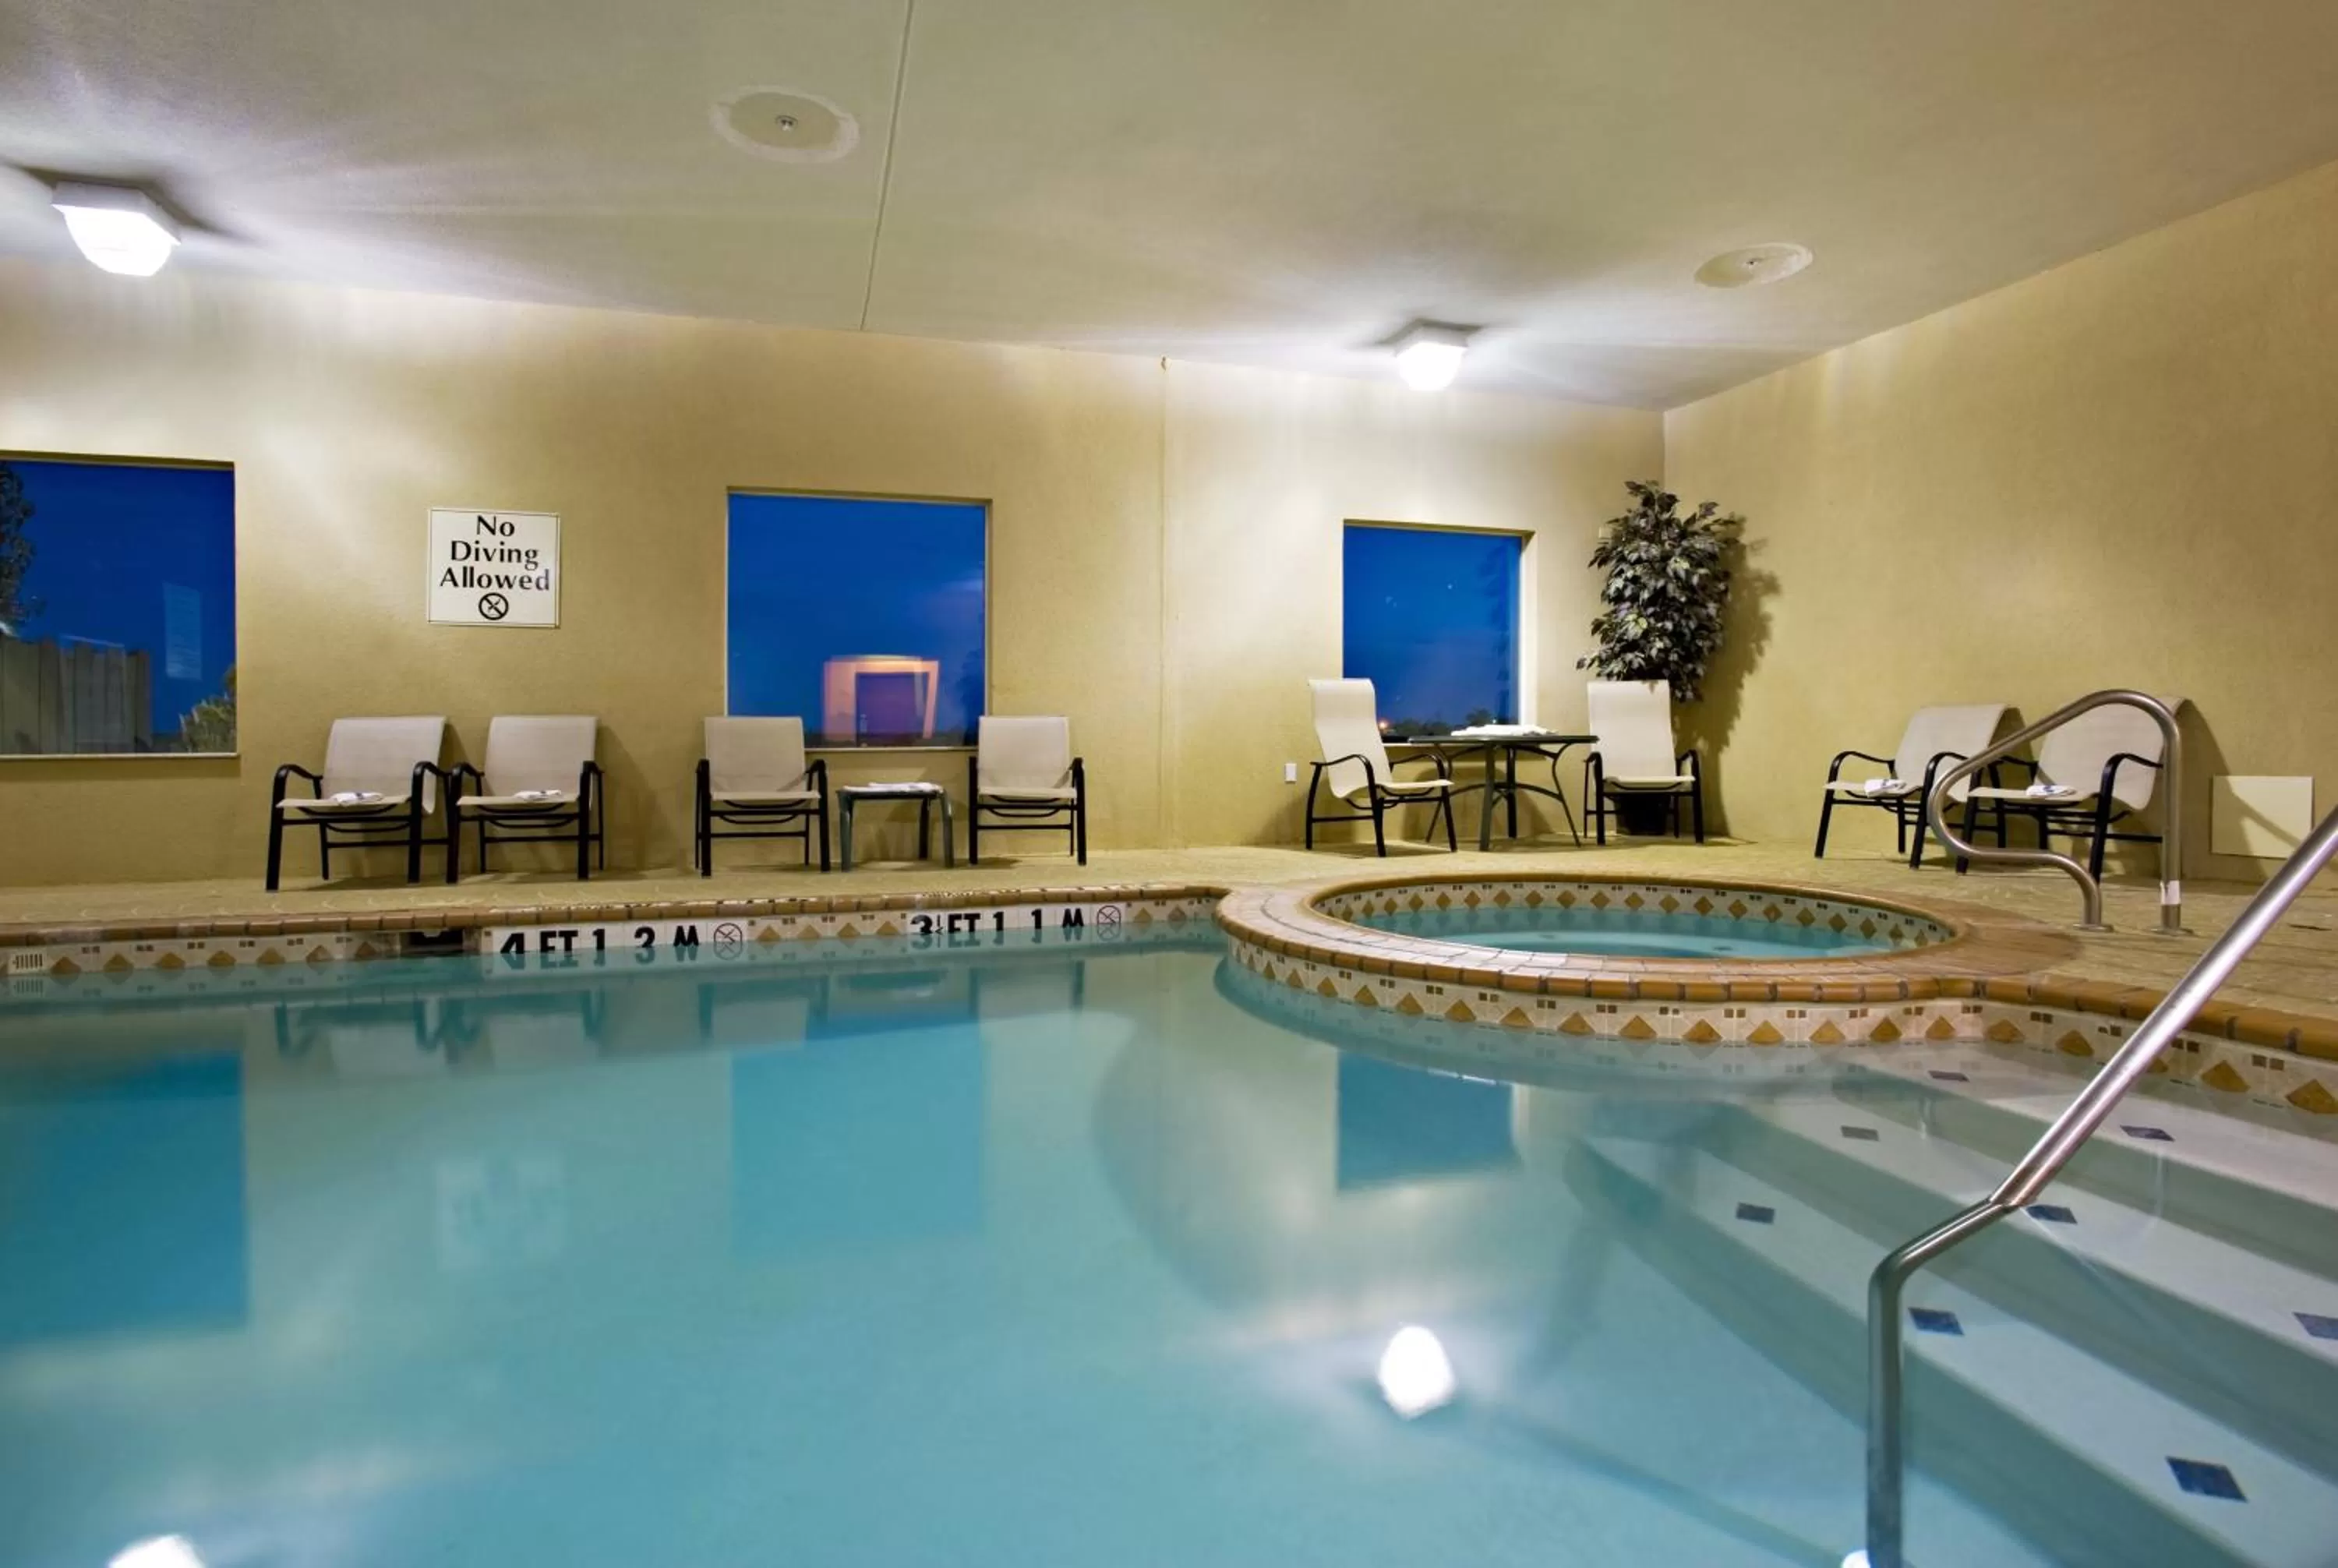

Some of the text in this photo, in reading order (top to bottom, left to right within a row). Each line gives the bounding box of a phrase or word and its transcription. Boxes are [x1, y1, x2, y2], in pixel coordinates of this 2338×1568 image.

[476, 514, 515, 537] No
[450, 539, 539, 571] Diving
[440, 566, 550, 592] Allowed
[1062, 907, 1085, 928] M
[540, 930, 579, 954] FT
[673, 924, 699, 947] M
